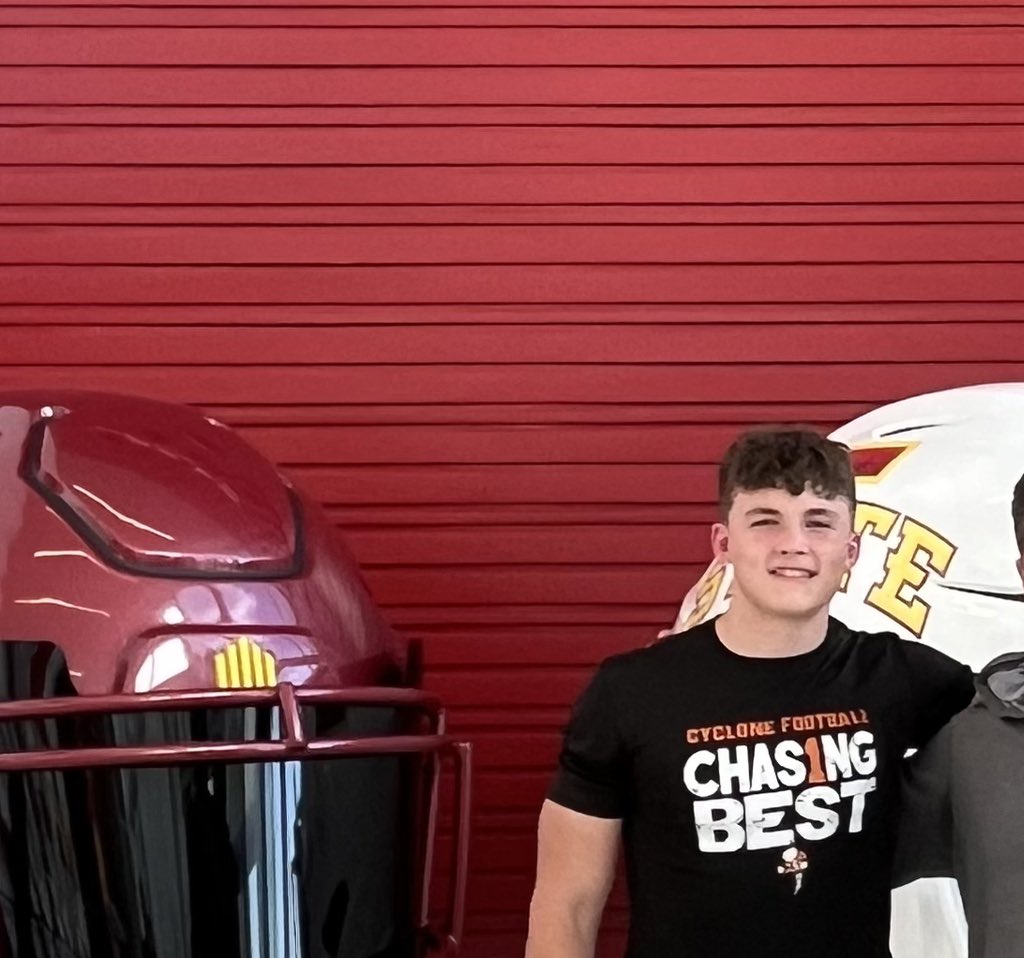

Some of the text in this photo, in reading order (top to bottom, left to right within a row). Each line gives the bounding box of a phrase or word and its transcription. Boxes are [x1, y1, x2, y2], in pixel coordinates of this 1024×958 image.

[686, 709, 869, 744] CYCLONE FOOTBALL
[693, 777, 877, 852] BEST
